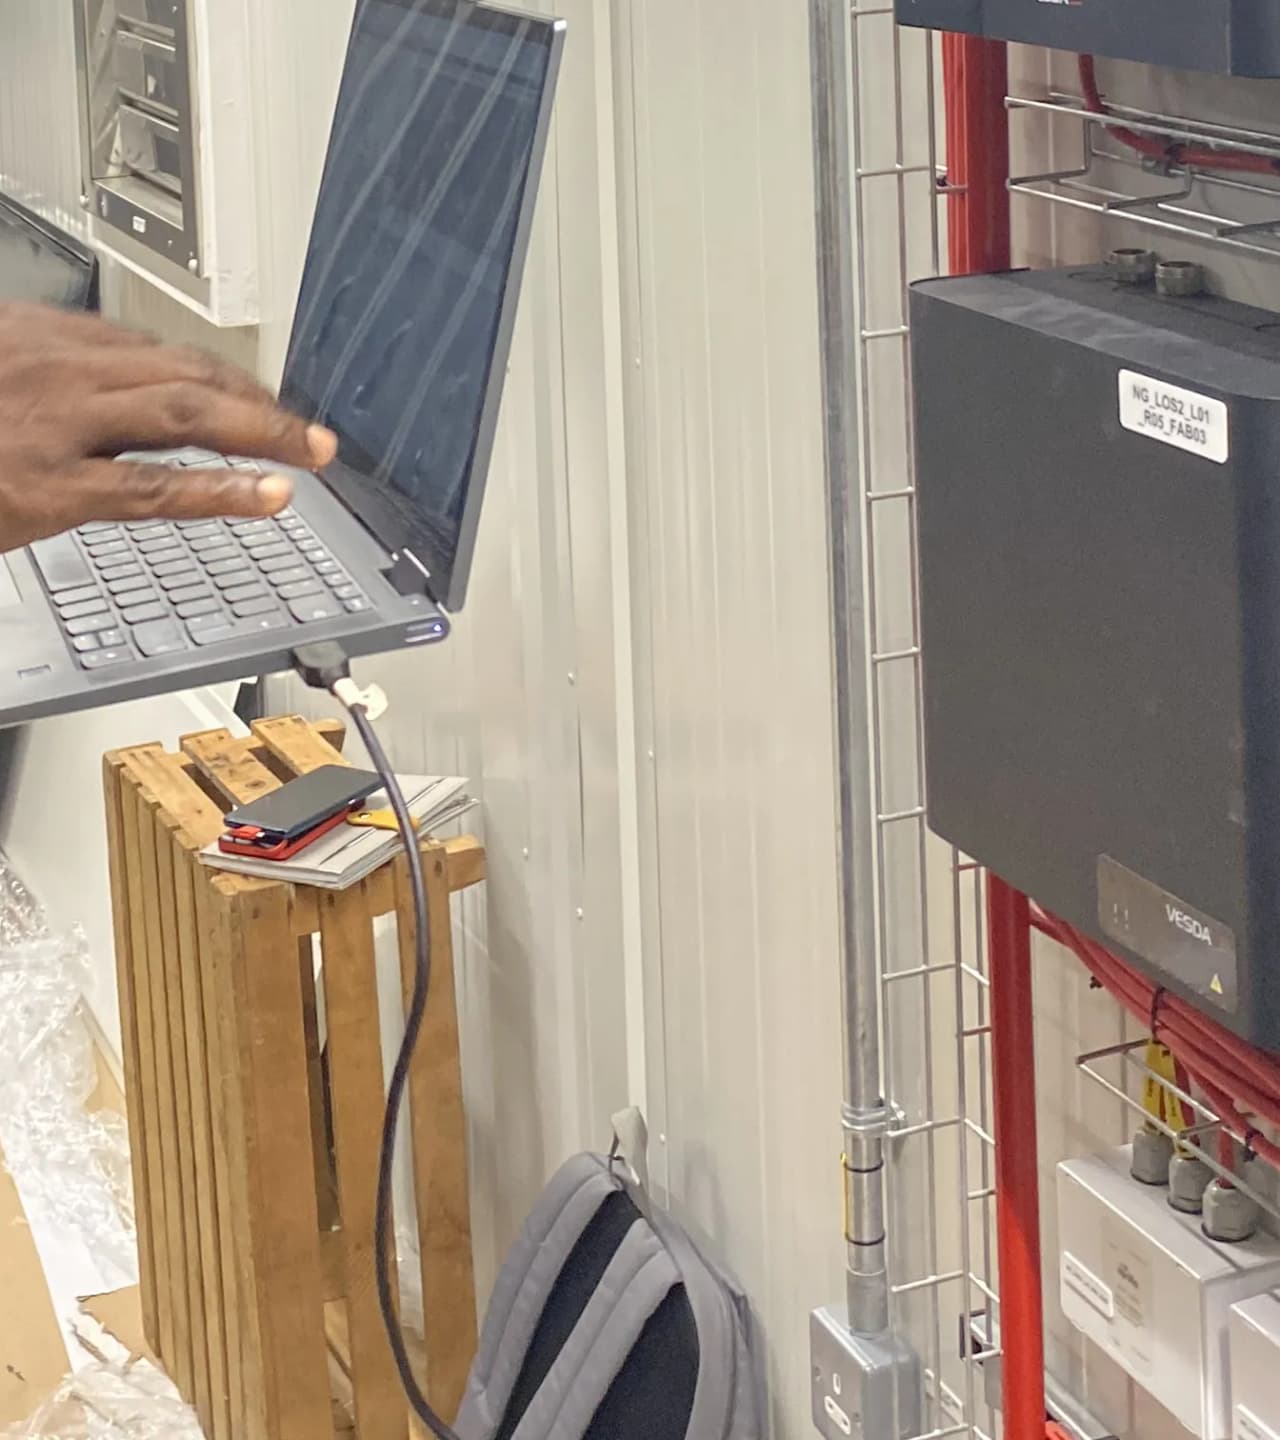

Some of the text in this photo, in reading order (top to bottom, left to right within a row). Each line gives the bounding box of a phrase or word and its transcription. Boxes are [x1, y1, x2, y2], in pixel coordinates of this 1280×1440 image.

[1132, 383, 1210, 425] NG_LOS2_L01
[1137, 409, 1207, 445] _R05_FAB03
[1165, 903, 1213, 947] VESDA
